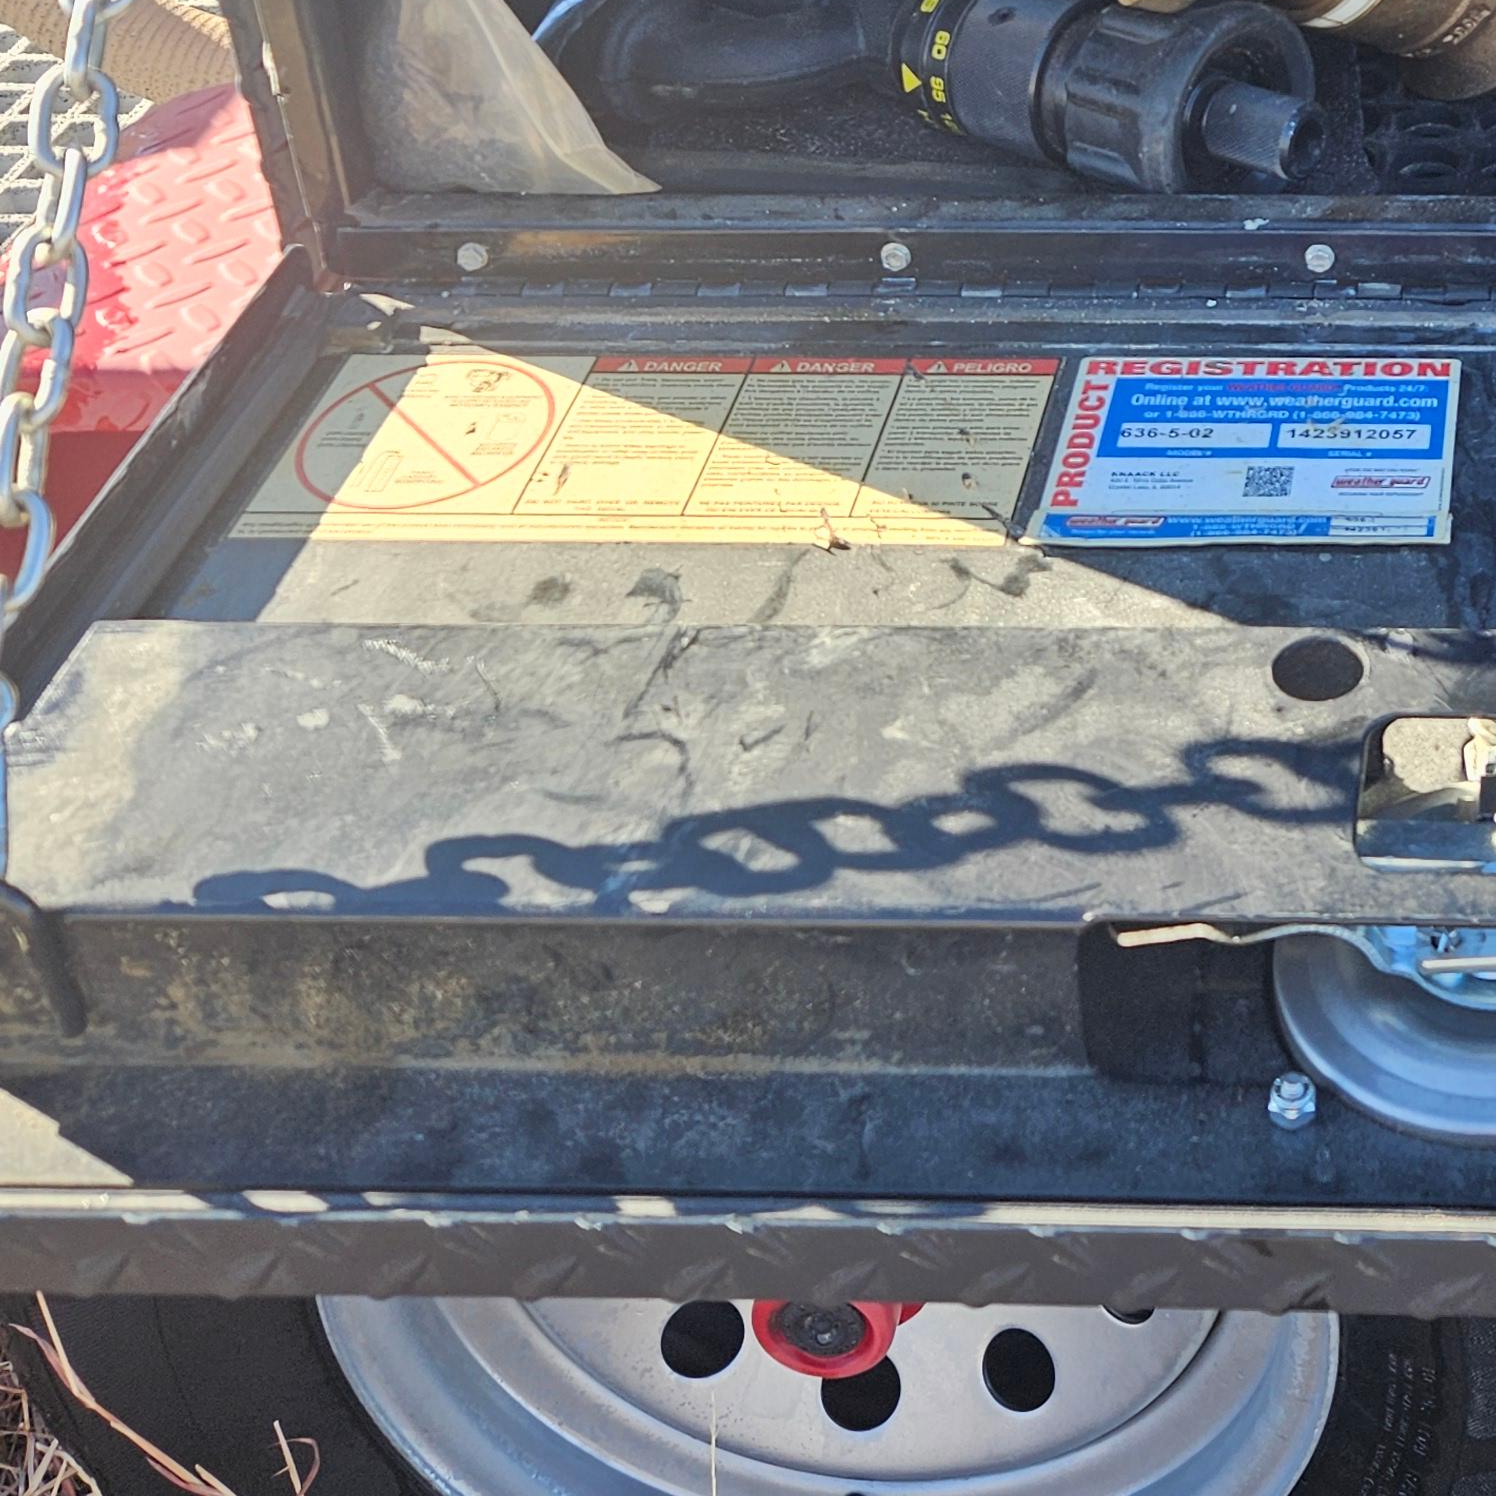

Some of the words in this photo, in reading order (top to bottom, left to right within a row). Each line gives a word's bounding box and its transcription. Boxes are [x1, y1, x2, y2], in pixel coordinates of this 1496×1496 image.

[930, 30, 951, 61] 60
[929, 76, 946, 104] 95
[643, 361, 723, 373] DANGER
[796, 361, 876, 373] DANGER
[953, 362, 1033, 373] PELIGRO
[1086, 360, 1452, 378] REGISTRATION
[1131, 393, 1189, 406] Online
[1193, 394, 1213, 406] at
[1216, 395, 1438, 409] www.weatherguard.com
[1120, 427, 1214, 439] 636-5-02
[1050, 380, 1110, 508] PRODUCT
